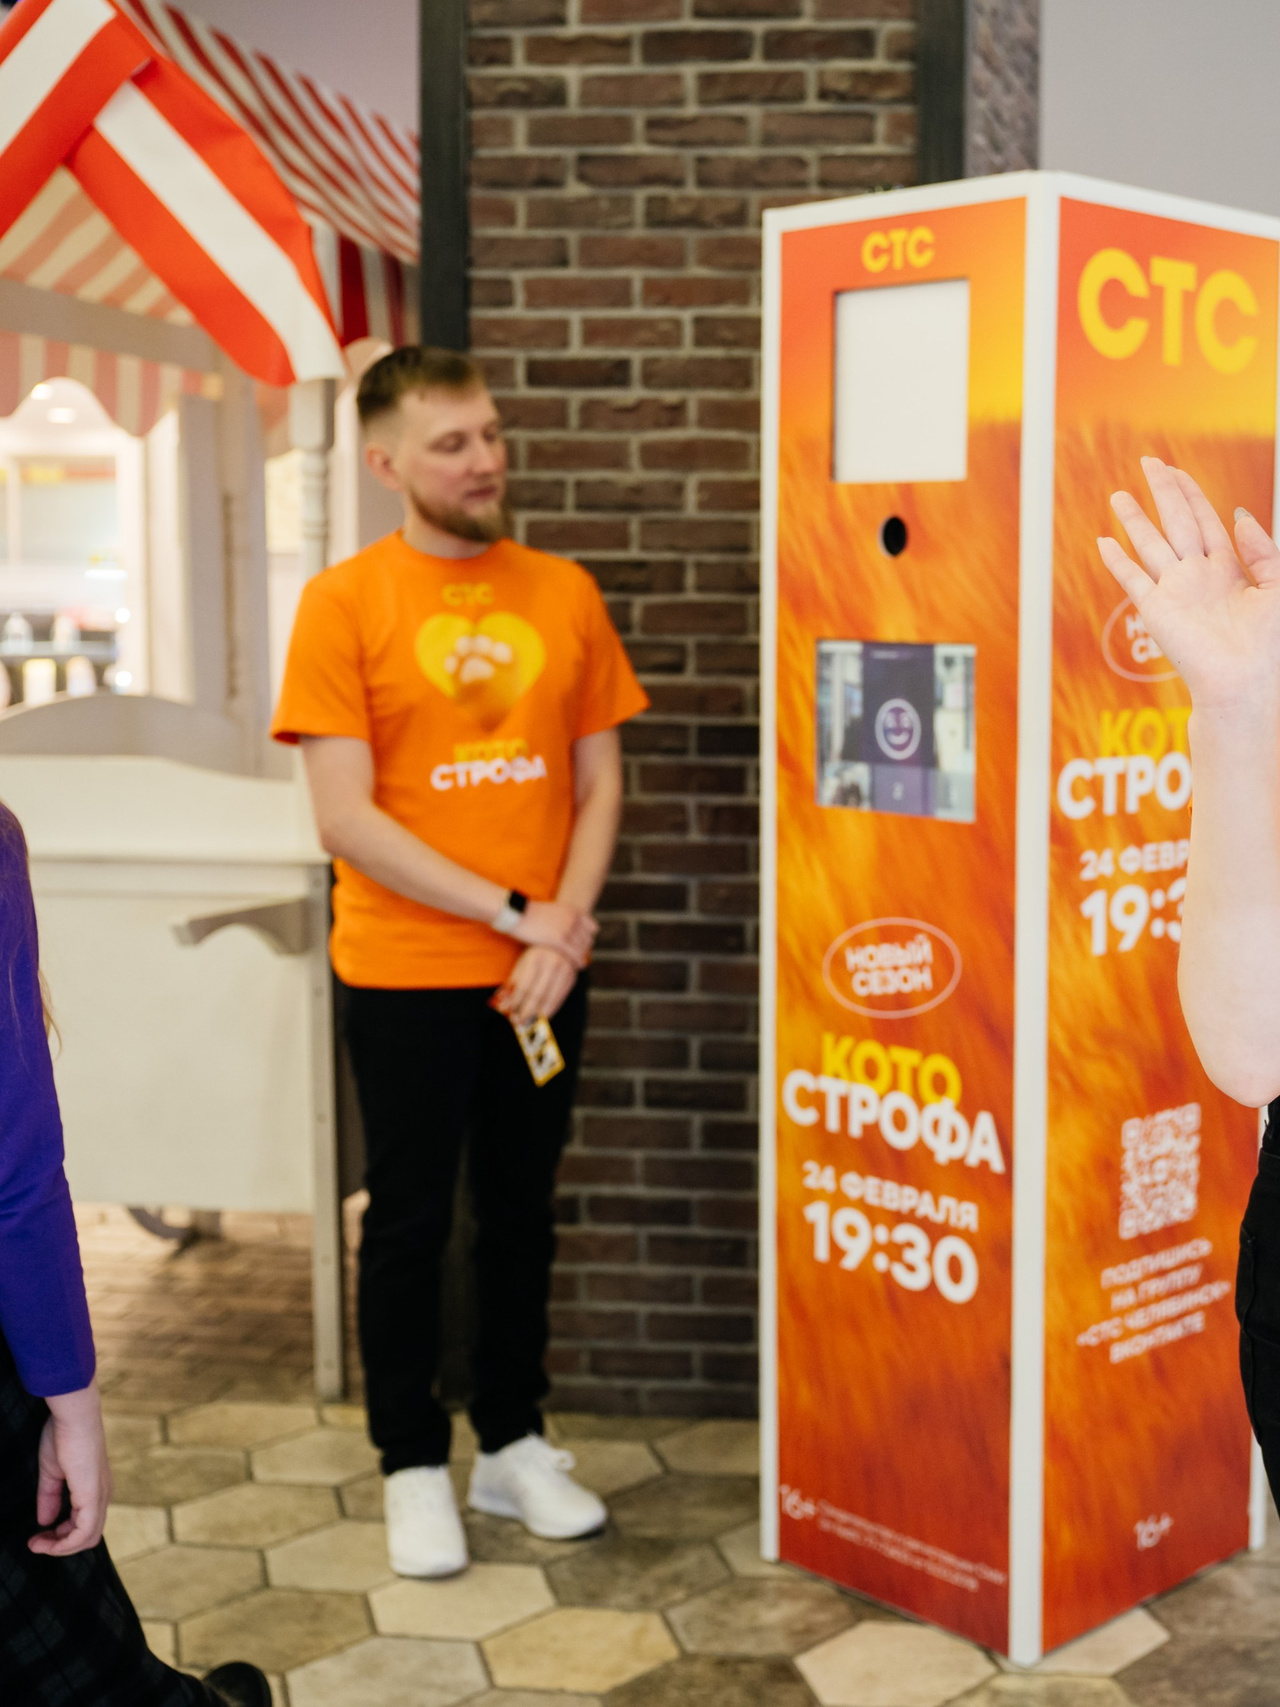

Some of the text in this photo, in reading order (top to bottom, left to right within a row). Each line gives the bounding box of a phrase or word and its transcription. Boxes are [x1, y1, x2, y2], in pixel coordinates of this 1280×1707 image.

[861, 226, 935, 272] СТС
[1077, 248, 1257, 375] СТС
[1101, 707, 1192, 759] КОТ
[430, 755, 547, 791] СТРОФА
[1057, 751, 1193, 820] СТРО
[1080, 839, 1190, 881] 24 ФЕВР
[844, 933, 933, 972] НОВЫЙ
[851, 965, 933, 997] СЕЗОН
[822, 1031, 963, 1110] КОТО
[782, 1068, 1006, 1175] СТРОФА
[803, 1159, 979, 1233] 24 ФЕВРАЛЯ
[803, 1200, 979, 1304] 19:30
